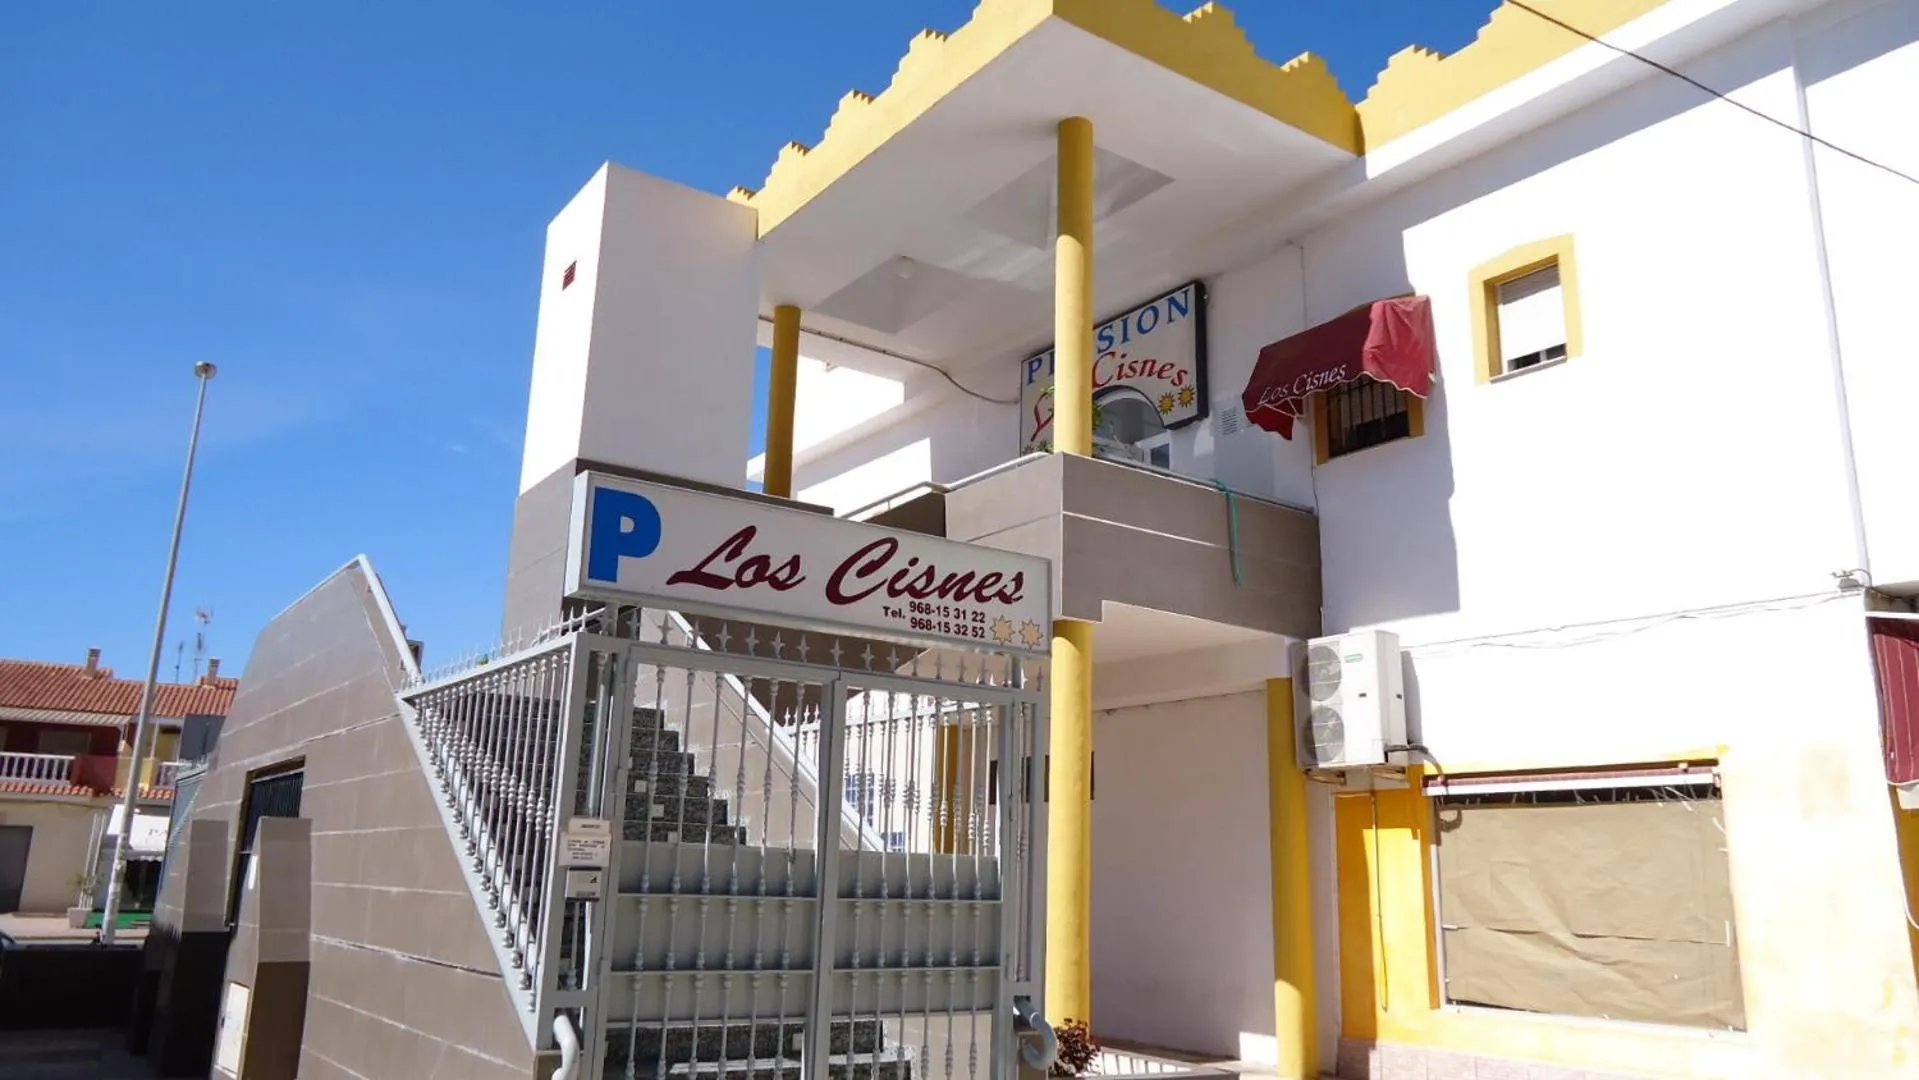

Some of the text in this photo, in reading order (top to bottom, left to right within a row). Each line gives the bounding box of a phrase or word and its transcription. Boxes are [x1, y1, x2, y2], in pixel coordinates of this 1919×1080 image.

[1026, 288, 1191, 386] PSION
[1092, 351, 1189, 389] Cisnes
[1257, 363, 1347, 406] Los Cisnes
[589, 486, 662, 583] P
[665, 525, 1025, 605] Los Cisnes
[882, 600, 986, 624] Tel. 968-15 31 22
[910, 617, 986, 639] 968-15 32 52
